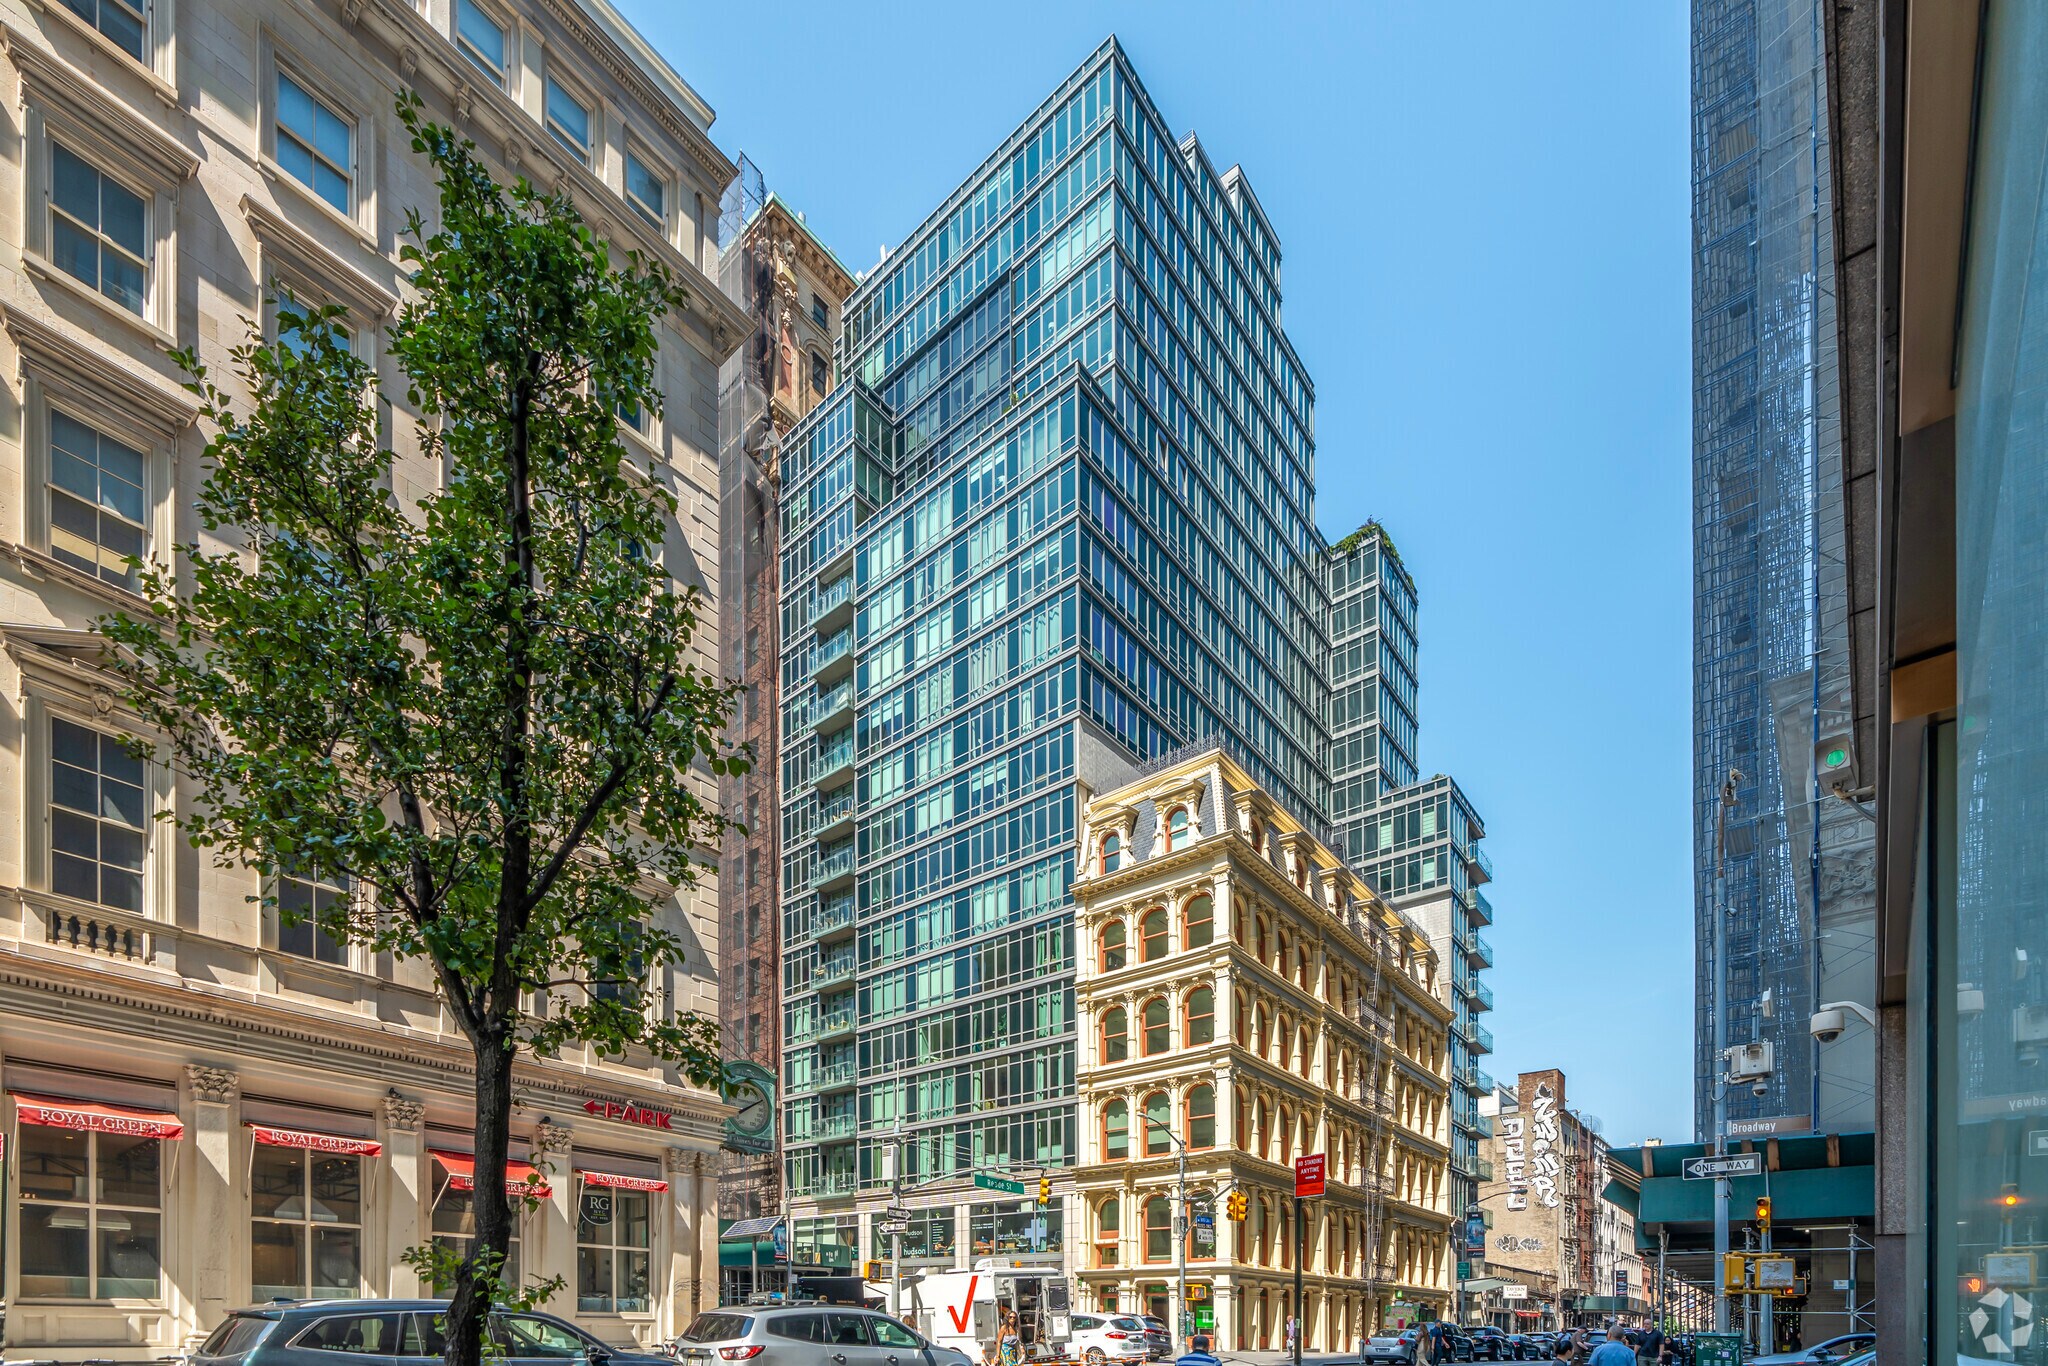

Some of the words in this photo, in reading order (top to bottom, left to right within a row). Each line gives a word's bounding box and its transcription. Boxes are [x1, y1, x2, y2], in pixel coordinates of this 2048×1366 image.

[40, 1109, 99, 1127] ROYAL
[103, 1117, 161, 1134] GREEN
[604, 1101, 673, 1130] PARK
[1732, 1121, 1776, 1134] Broadway
[271, 1130, 317, 1146] ROYAL
[319, 1138, 364, 1152] GREEN
[1304, 1157, 1323, 1166] STANDING
[1694, 1163, 1716, 1172] ONE
[1726, 1160, 1750, 1170] WAY
[1300, 1166, 1320, 1175] ANYTIME
[596, 1174, 626, 1186] ROYAL
[626, 1177, 657, 1189] GREEN
[1006, 1182, 1012, 1191] St
[589, 1196, 610, 1210] RG
[905, 1229, 923, 1237] hudson
[903, 1247, 926, 1256] hudson
[1199, 1309, 1214, 1323] TD
